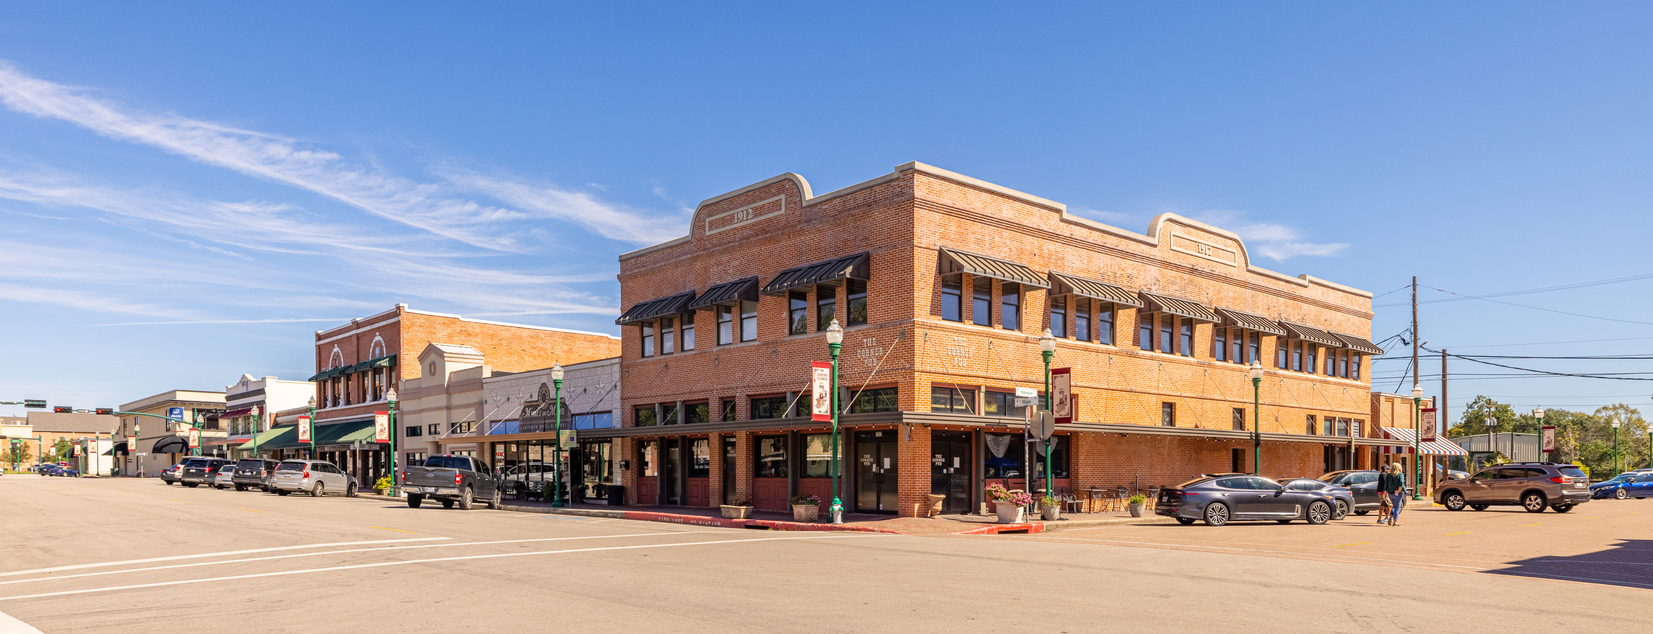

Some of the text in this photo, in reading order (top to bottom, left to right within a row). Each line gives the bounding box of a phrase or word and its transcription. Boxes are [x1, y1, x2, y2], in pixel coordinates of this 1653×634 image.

[734, 208, 753, 223] 1912
[1197, 244, 1212, 256] 1912
[863, 337, 877, 347] THE
[954, 337, 966, 346] THE
[857, 347, 884, 358] CORNER
[947, 346, 972, 358] CORNER
[864, 357, 878, 367] PUB
[953, 357, 966, 367] PUB
